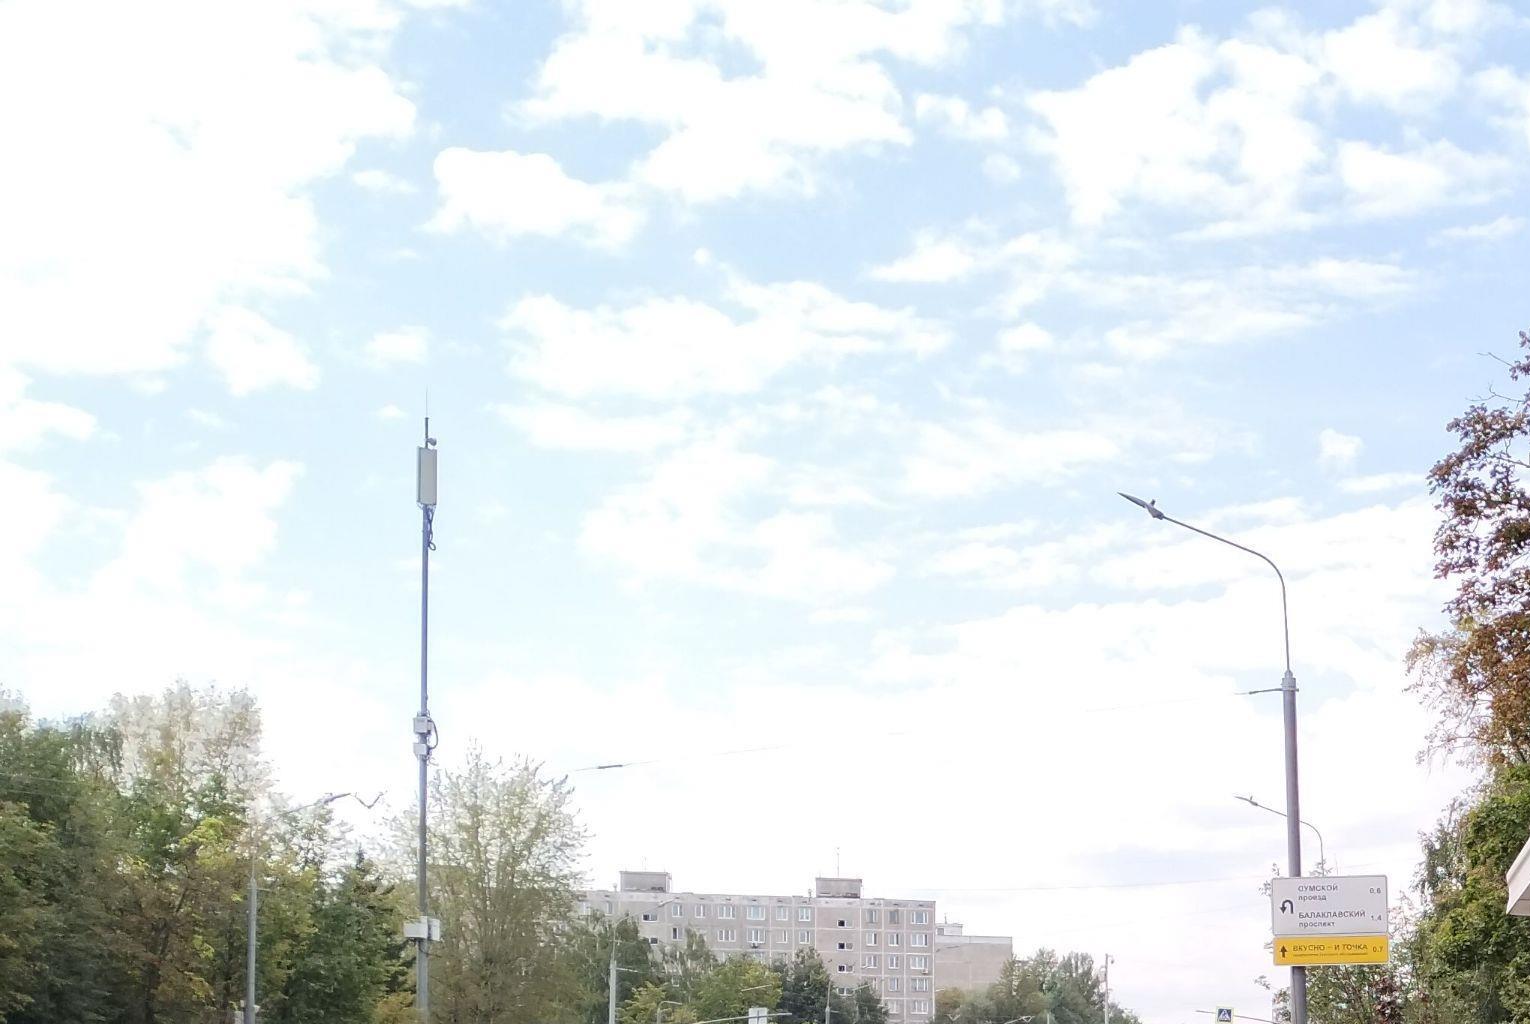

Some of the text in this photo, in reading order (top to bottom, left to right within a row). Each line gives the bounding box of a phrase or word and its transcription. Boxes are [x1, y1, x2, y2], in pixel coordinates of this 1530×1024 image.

[1298, 910, 1366, 919] БАЛАКЛАВСКИЙ
[1298, 921, 1335, 929] проспект
[1293, 944, 1326, 952] ВКУСНО
